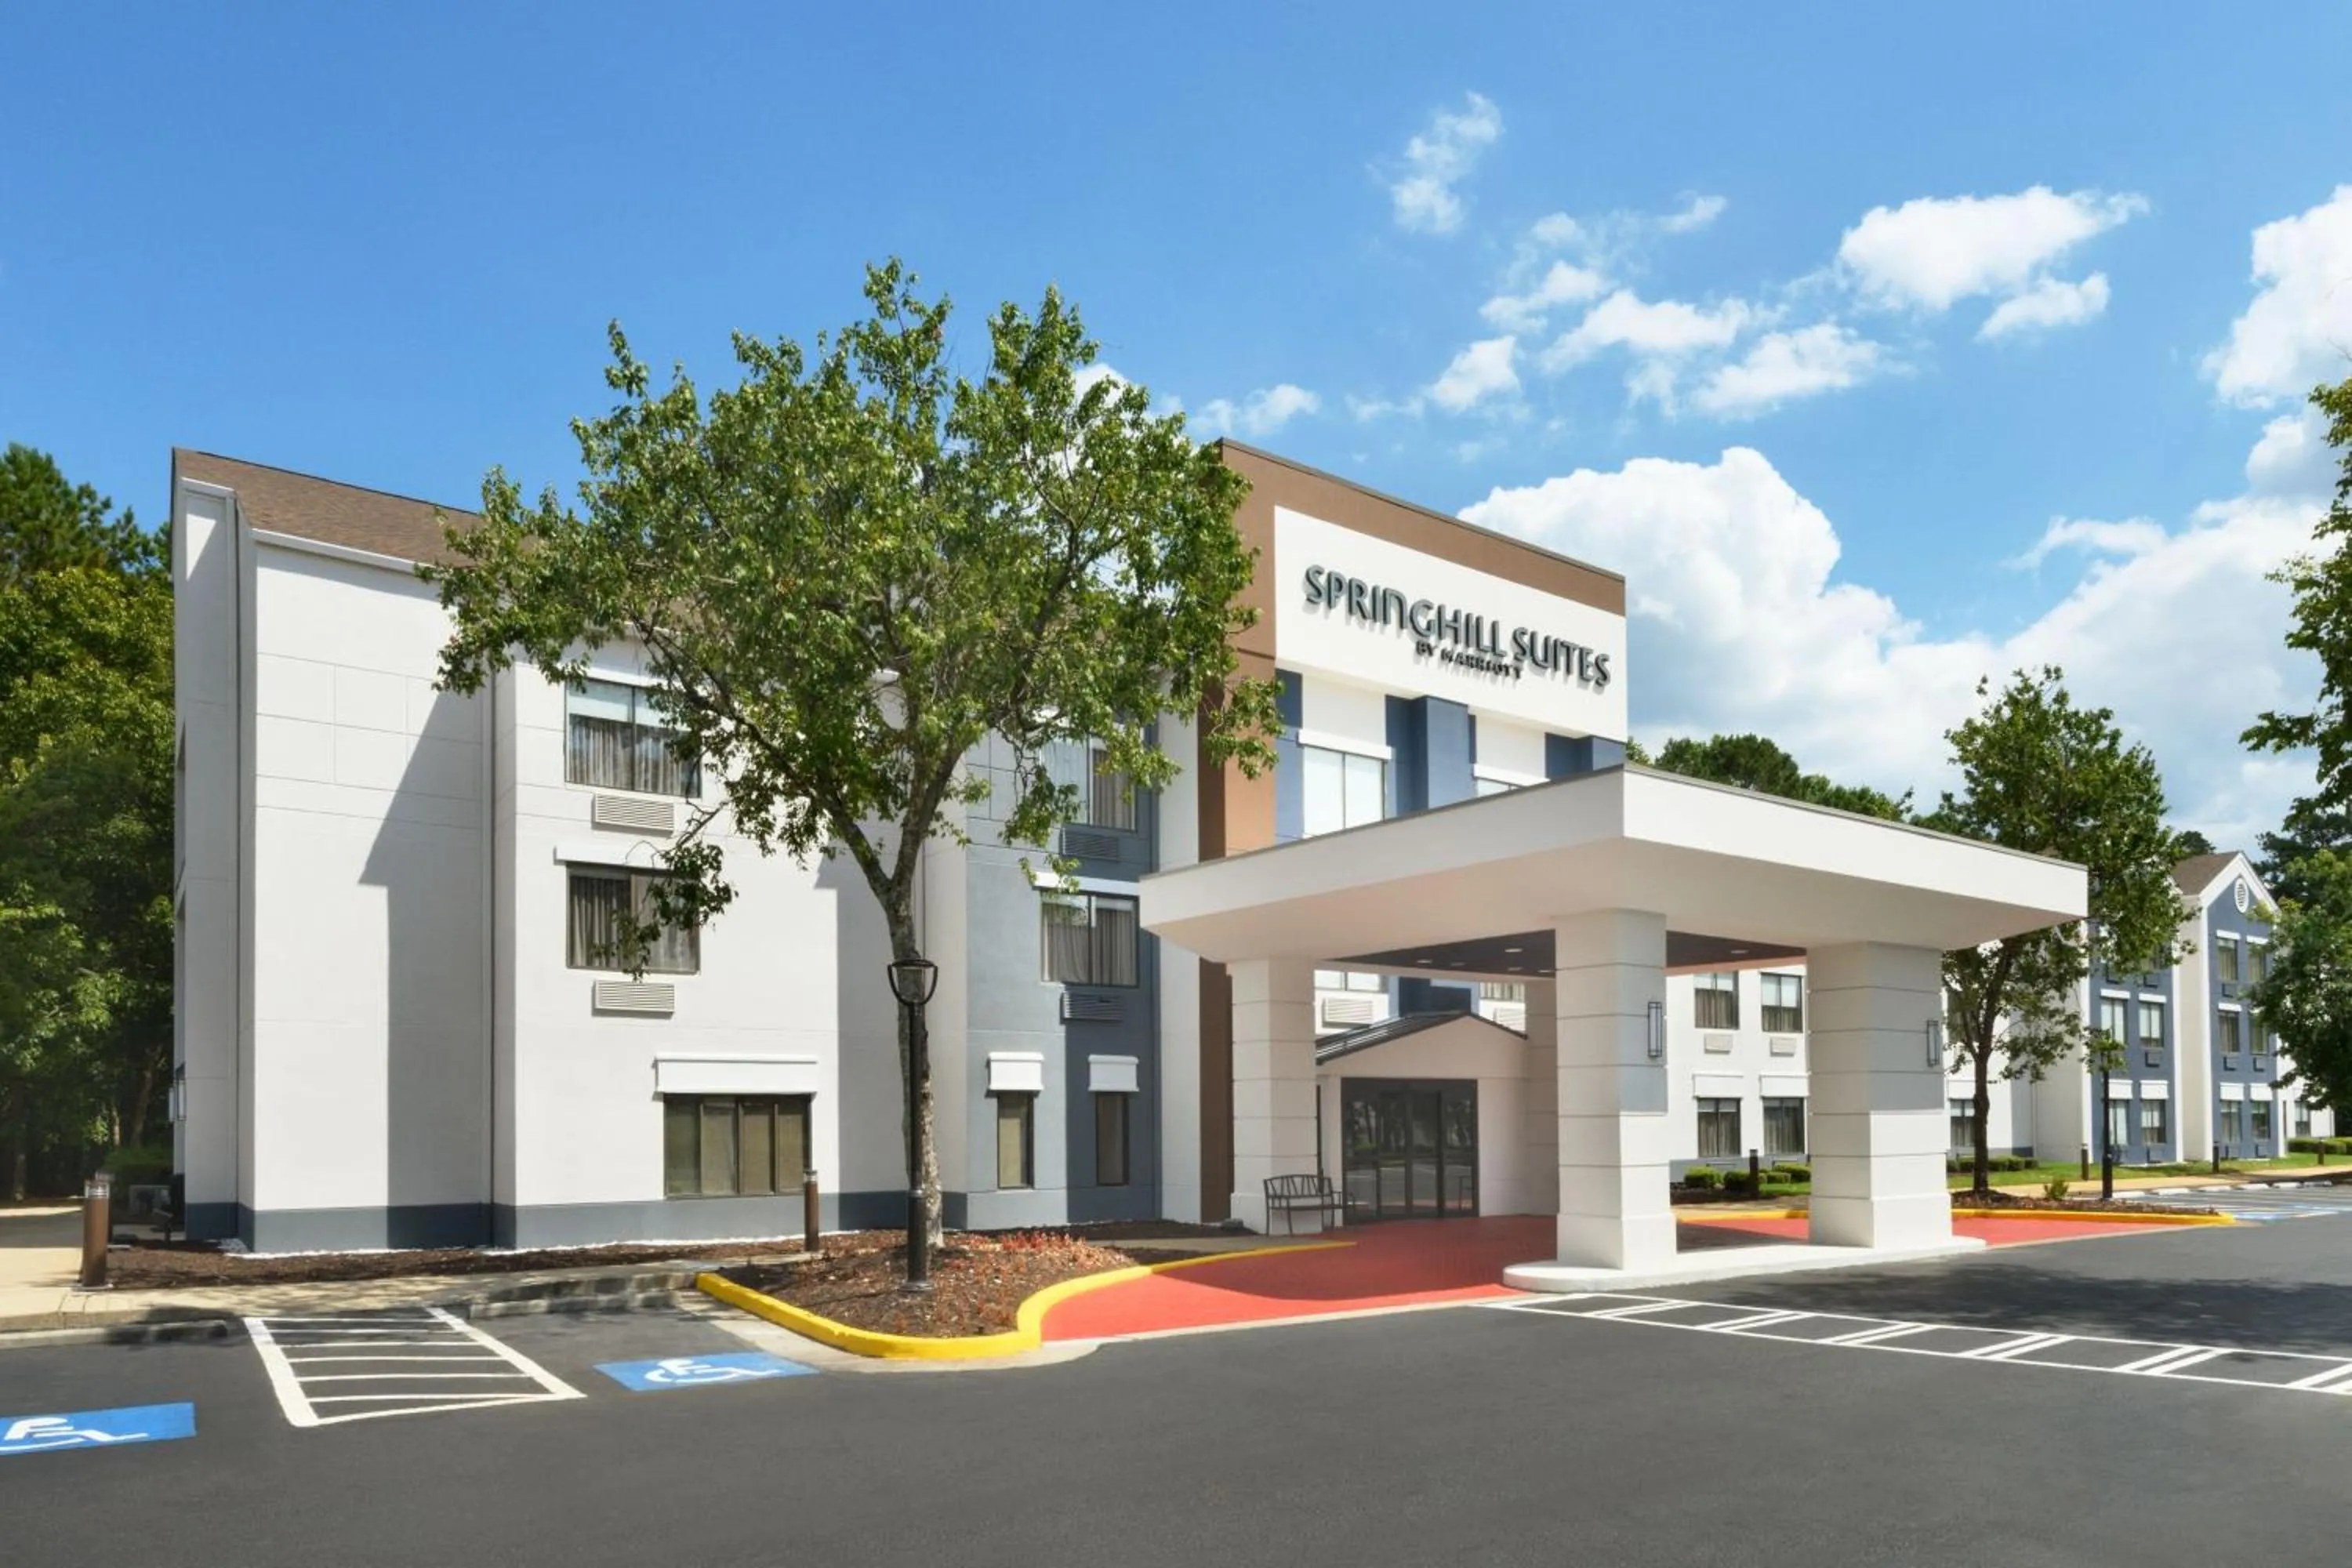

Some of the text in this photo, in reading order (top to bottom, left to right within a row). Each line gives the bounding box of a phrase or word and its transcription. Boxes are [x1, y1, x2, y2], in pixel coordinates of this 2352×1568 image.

[1305, 564, 1610, 688] SPRINGHILL SUITES
[1415, 640, 1522, 679] BY MARRIOTT
